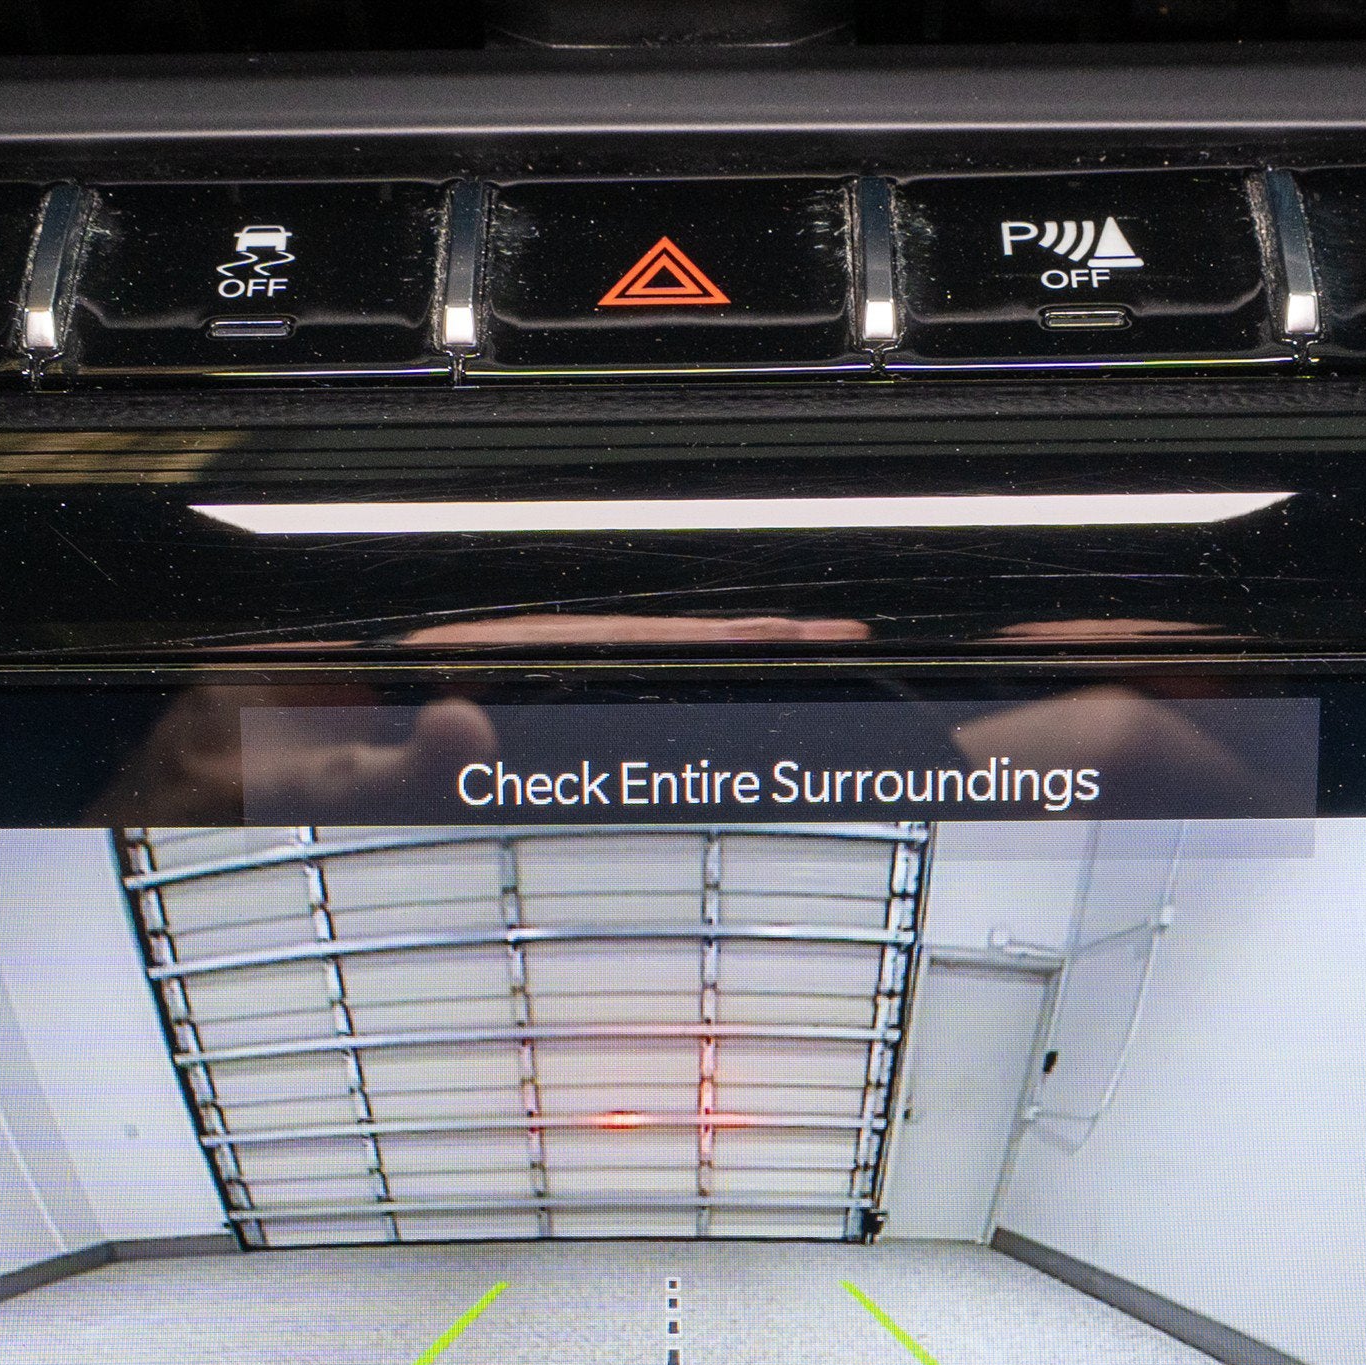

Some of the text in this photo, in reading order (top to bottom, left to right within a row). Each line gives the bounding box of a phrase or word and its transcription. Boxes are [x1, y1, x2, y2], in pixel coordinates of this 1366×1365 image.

[1001, 221, 1039, 256] P
[218, 278, 289, 298] OFF
[1040, 269, 1111, 289] OFF
[457, 757, 1101, 812] Check Entire Surroundings
